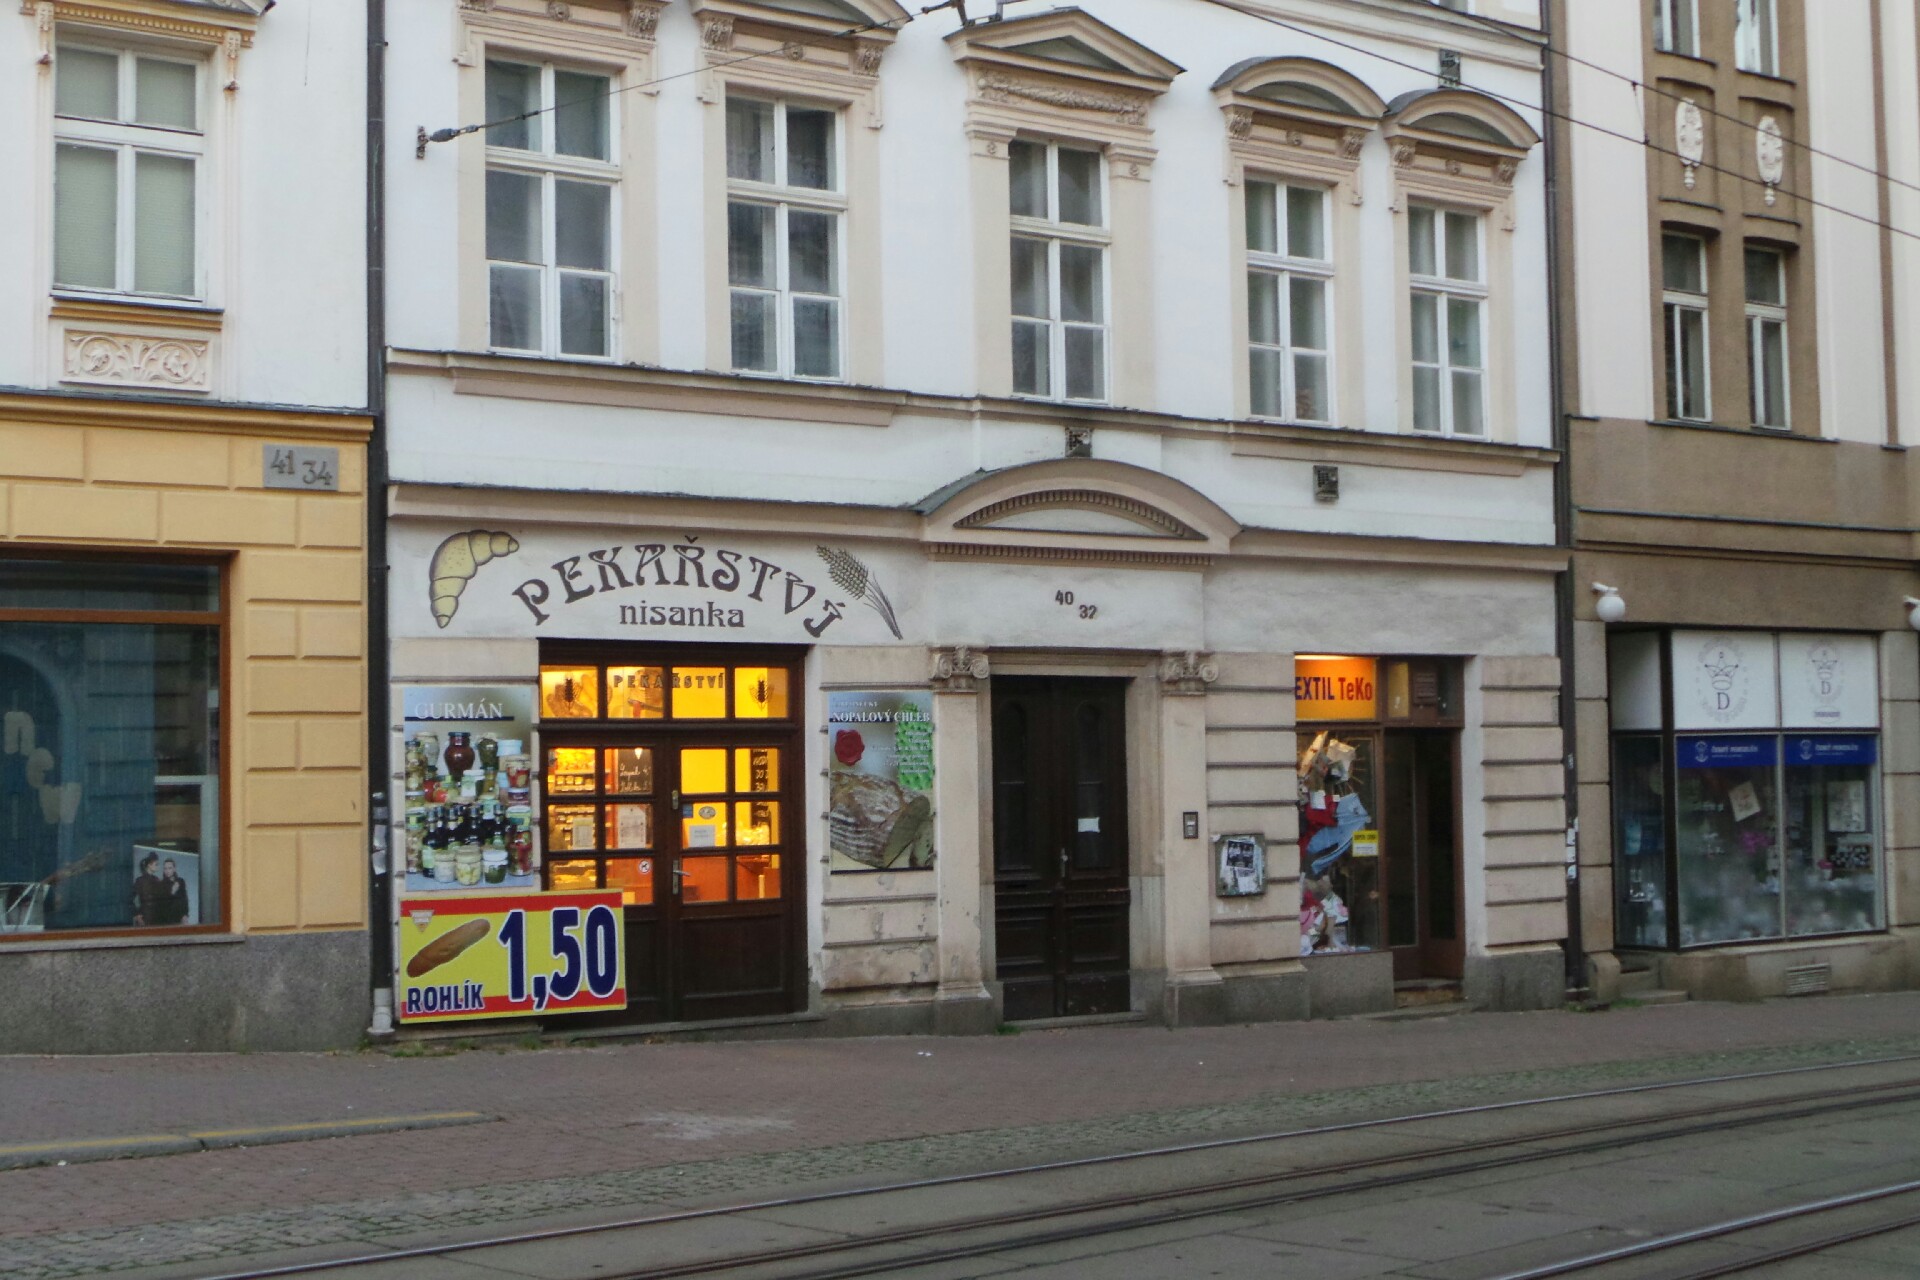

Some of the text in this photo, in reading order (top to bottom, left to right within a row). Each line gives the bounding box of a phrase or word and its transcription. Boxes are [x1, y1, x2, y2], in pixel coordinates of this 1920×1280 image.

[270, 449, 333, 486] 41 34
[511, 535, 846, 638] PEKAŘSTVÍ
[619, 600, 746, 629] nisanka
[1055, 589, 1097, 620] 40 32
[613, 671, 726, 689] PEKAŘSTVÍ
[1295, 676, 1373, 701] EXTIL TeKo
[414, 697, 503, 720] GURMÁN
[832, 708, 891, 722] NOPALOVÝ
[1717, 692, 1730, 711] D
[496, 904, 619, 1012] 1,50
[406, 980, 485, 1013] ROHLÍK
